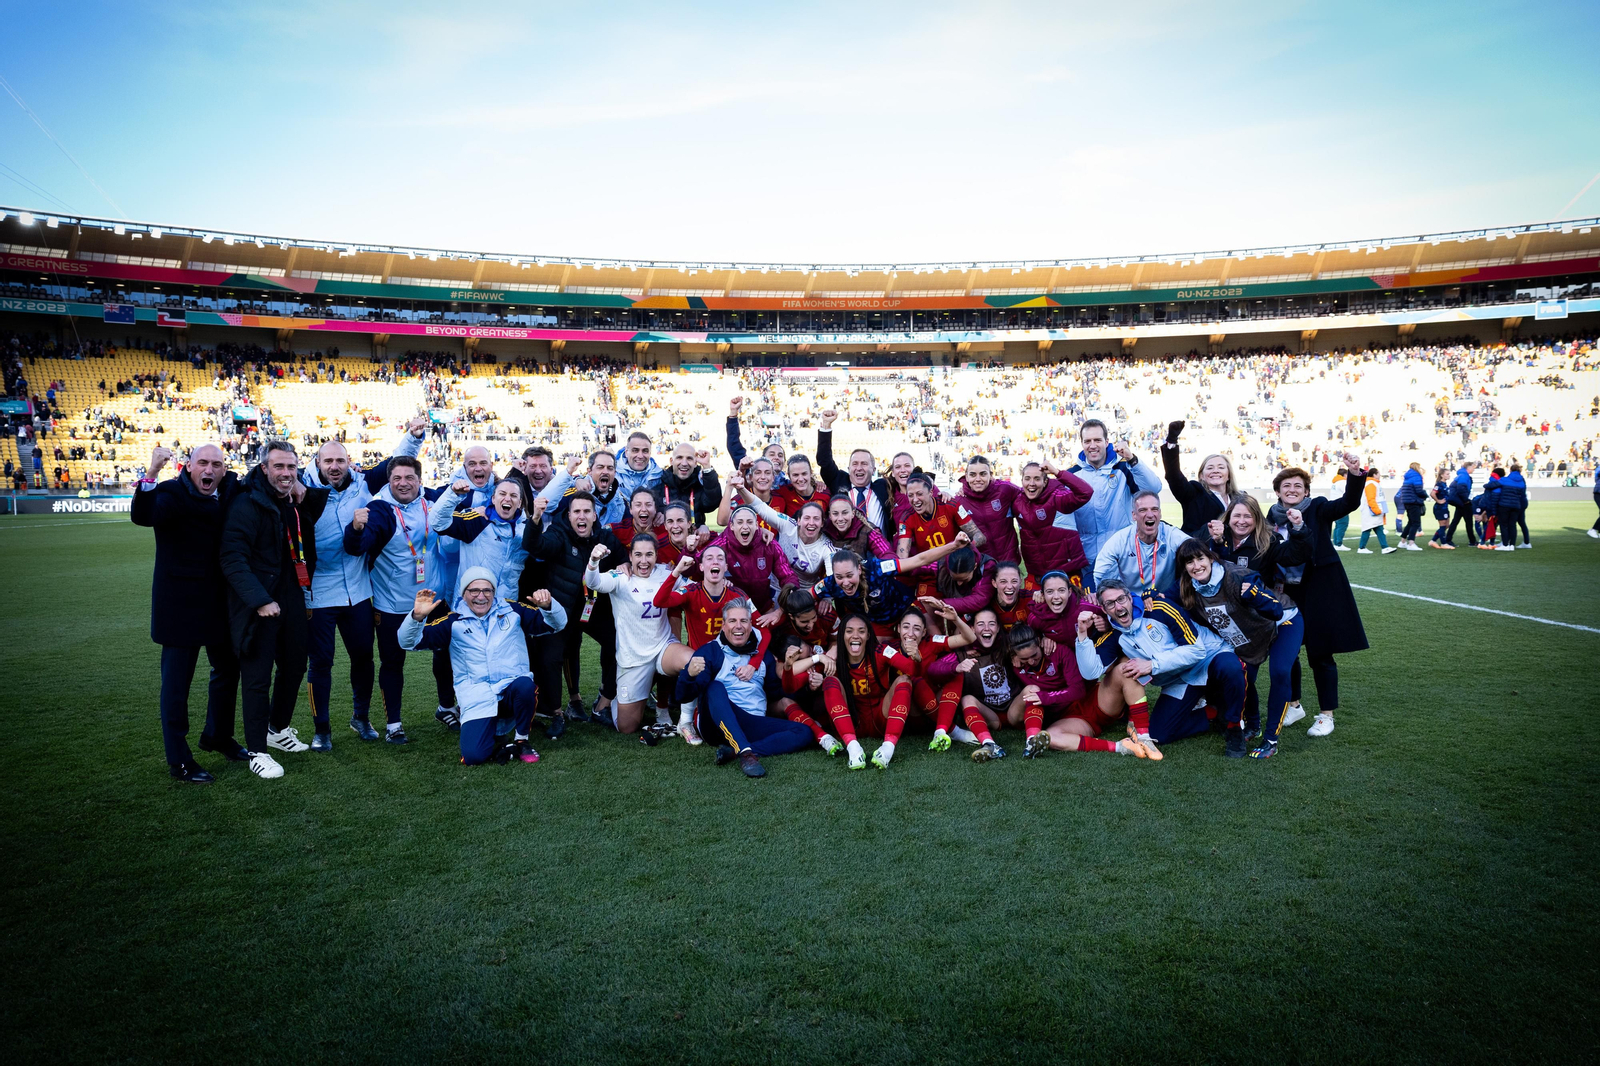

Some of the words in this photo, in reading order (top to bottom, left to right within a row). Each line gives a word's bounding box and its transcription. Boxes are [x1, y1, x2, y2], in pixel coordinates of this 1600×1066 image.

[8, 257, 88, 273] GREATNESS
[450, 291, 505, 301] #FIFAWWC
[782, 300, 801, 308] FIFA
[802, 300, 846, 308] WOMEN'S
[847, 300, 880, 308] WORLD
[882, 300, 901, 308] CUP
[425, 326, 467, 336] BEYOND
[469, 328, 528, 338] GREATNESS
[758, 334, 817, 343] WELLINGTON
[822, 334, 834, 342] TE
[926, 531, 946, 549] 10
[851, 679, 871, 696] 18
